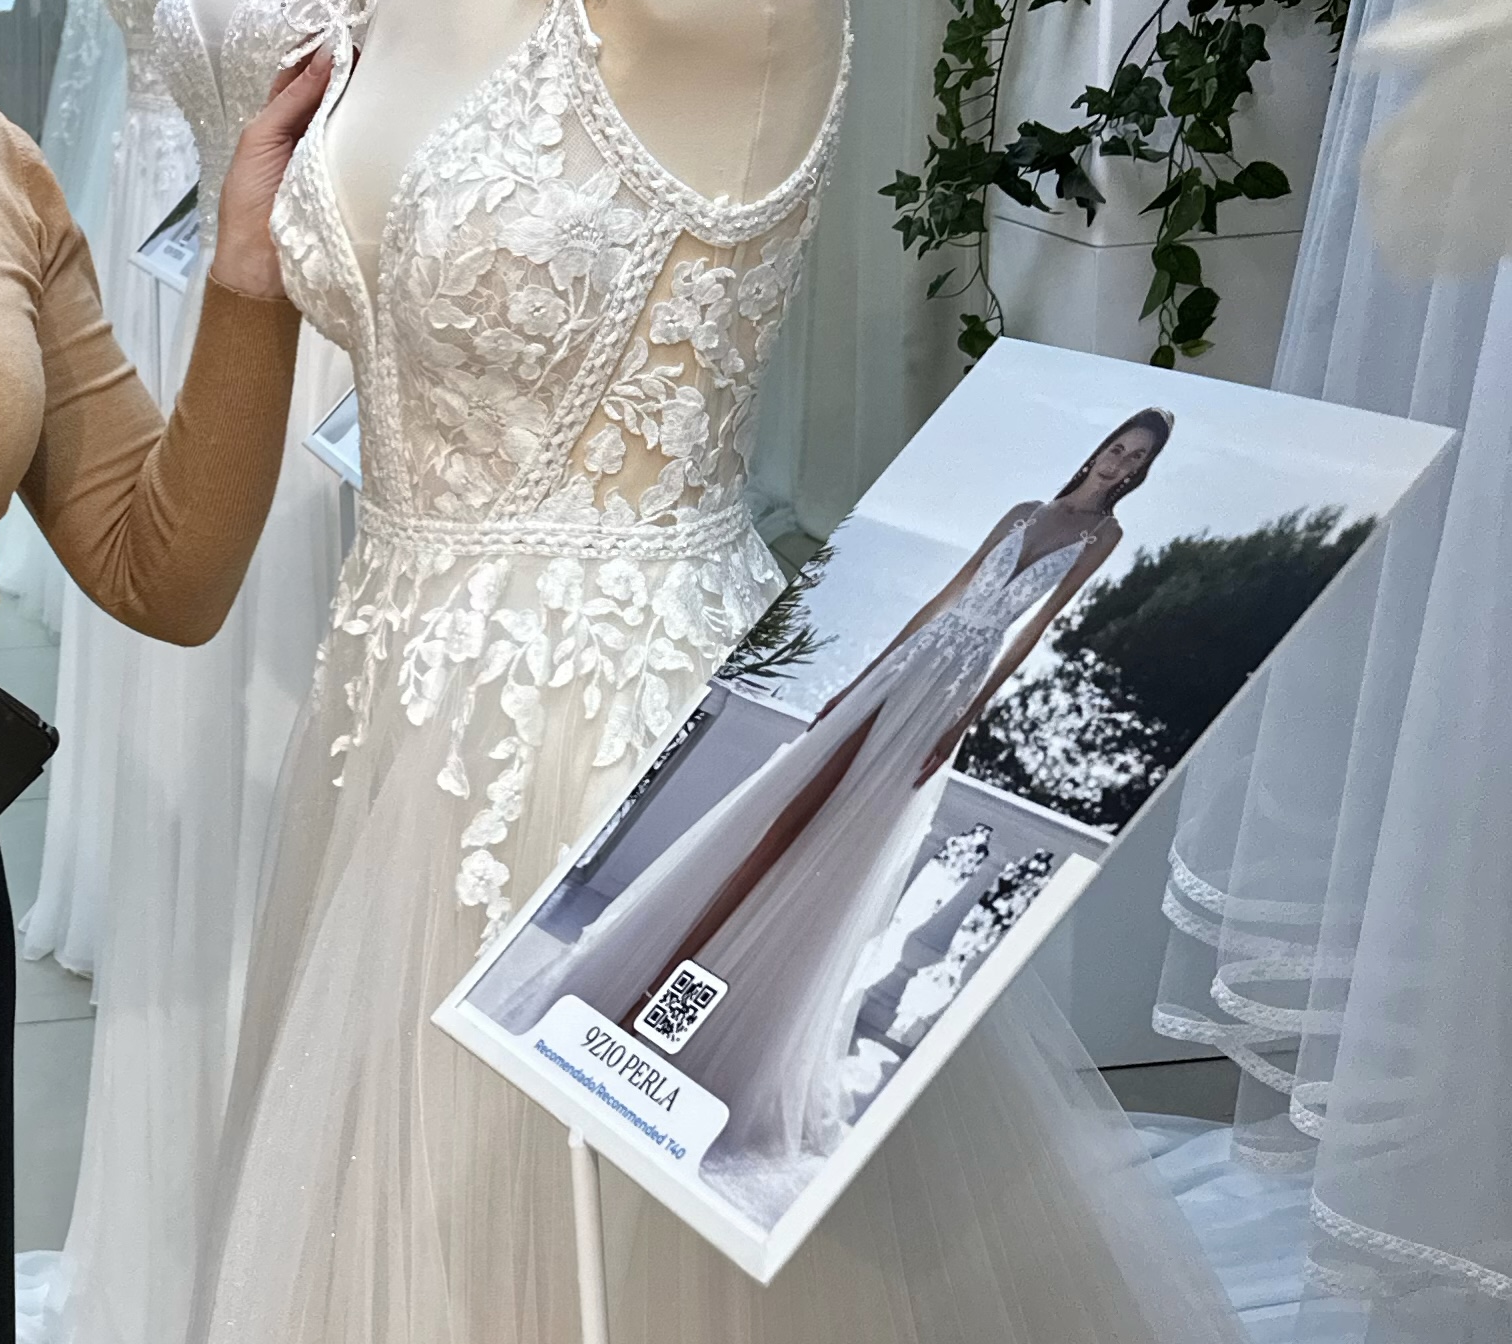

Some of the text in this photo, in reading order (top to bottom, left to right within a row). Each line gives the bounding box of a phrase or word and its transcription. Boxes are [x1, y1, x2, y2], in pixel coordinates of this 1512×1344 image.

[534, 1039, 687, 1160] Recomendado/Recommended T40
[580, 1025, 681, 1112] 9Z10 PERLA
